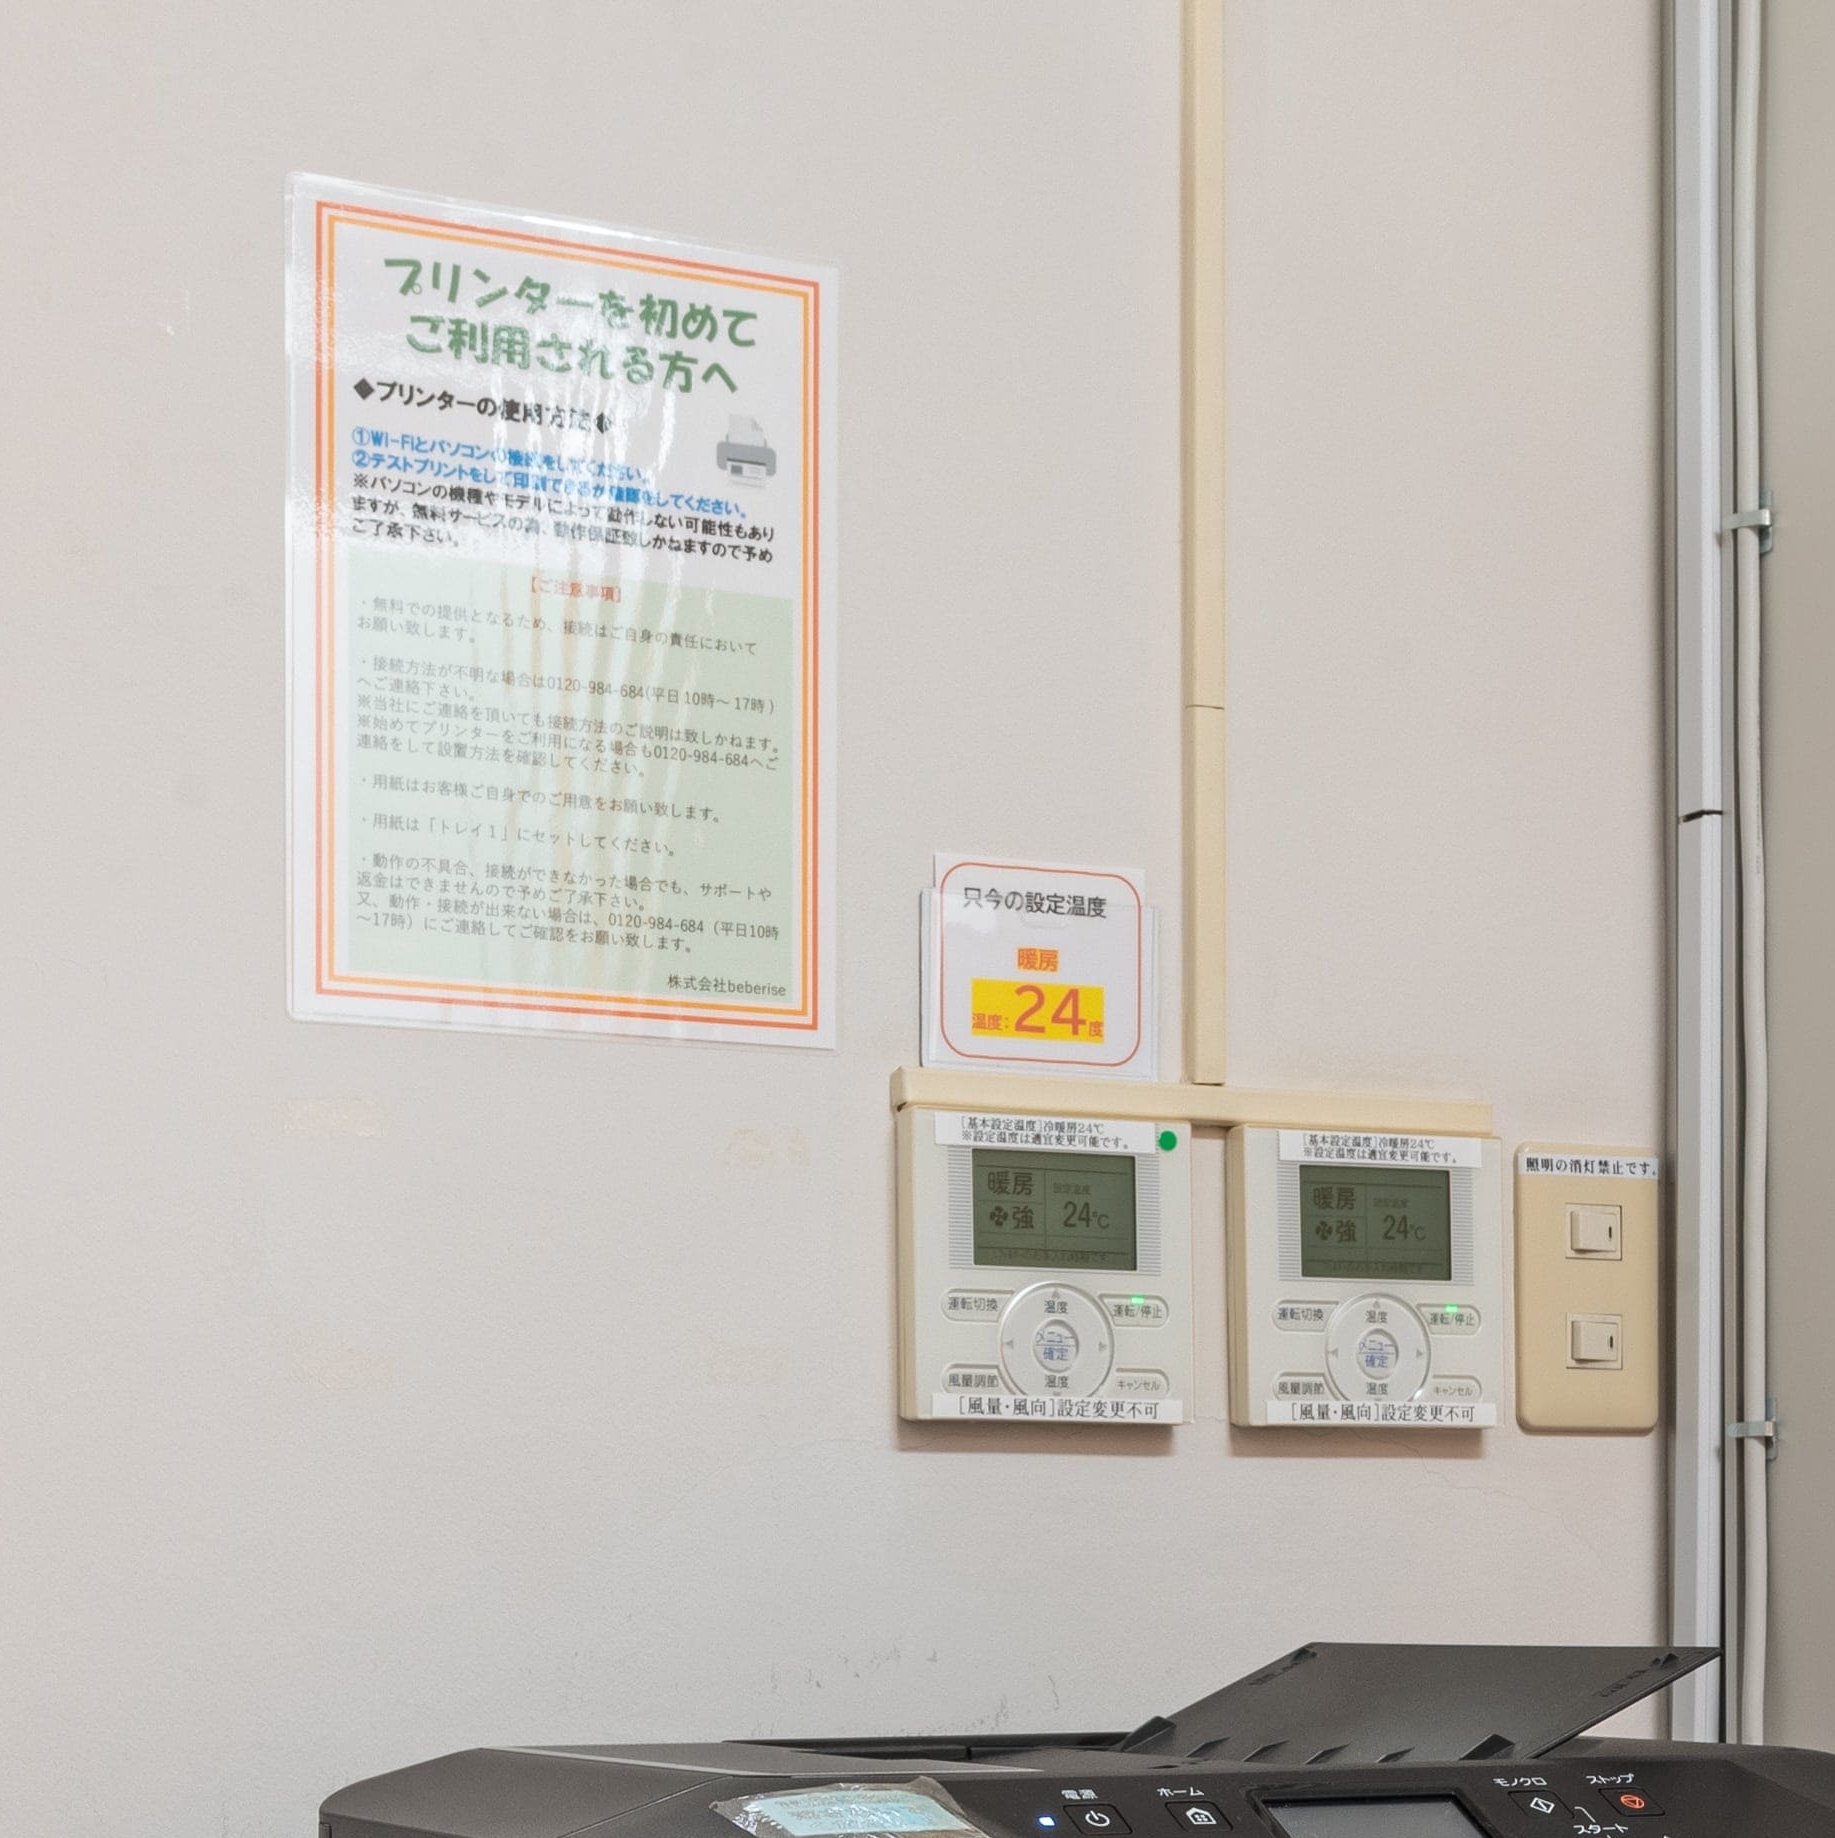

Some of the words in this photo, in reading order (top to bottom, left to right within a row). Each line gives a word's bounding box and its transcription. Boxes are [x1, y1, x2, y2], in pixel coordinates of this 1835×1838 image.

[385, 259, 759, 349] プリンターを初めて
[405, 312, 738, 394] ご利用される方へ
[353, 518, 459, 546] ご了承下さい。
[357, 616, 475, 643] お願い致します。
[963, 887, 1107, 919] 只今の設定温度
[1017, 948, 1059, 972] 暖房
[1525, 1158, 1657, 1177] 照明の消灯禁止です。
[987, 1171, 1034, 1197] 暖房
[1313, 1186, 1356, 1211] 暖房
[1012, 1205, 1035, 1230] 強
[948, 1297, 998, 1312] 運転切換
[1044, 1301, 1069, 1314] 温度
[1113, 1303, 1162, 1319] 運転/停止
[1277, 1308, 1324, 1322] 運転切換
[1365, 1310, 1388, 1324] 温度
[1428, 1313, 1475, 1327] 運転/停止
[948, 1373, 998, 1389] 風量調節
[1044, 1375, 1069, 1388] 温度
[1117, 1379, 1161, 1392] キャンセル
[1278, 1382, 1325, 1396] 風量調節
[1366, 1383, 1388, 1396] 温度
[1433, 1385, 1473, 1397] キャンセル
[1493, 1776, 1548, 1787] モノクロ
[1585, 1773, 1634, 1785] ストップ
[1061, 1788, 1098, 1799] 電源
[1156, 1786, 1204, 1798] ホーム
[1573, 1823, 1629, 1834] スタート
